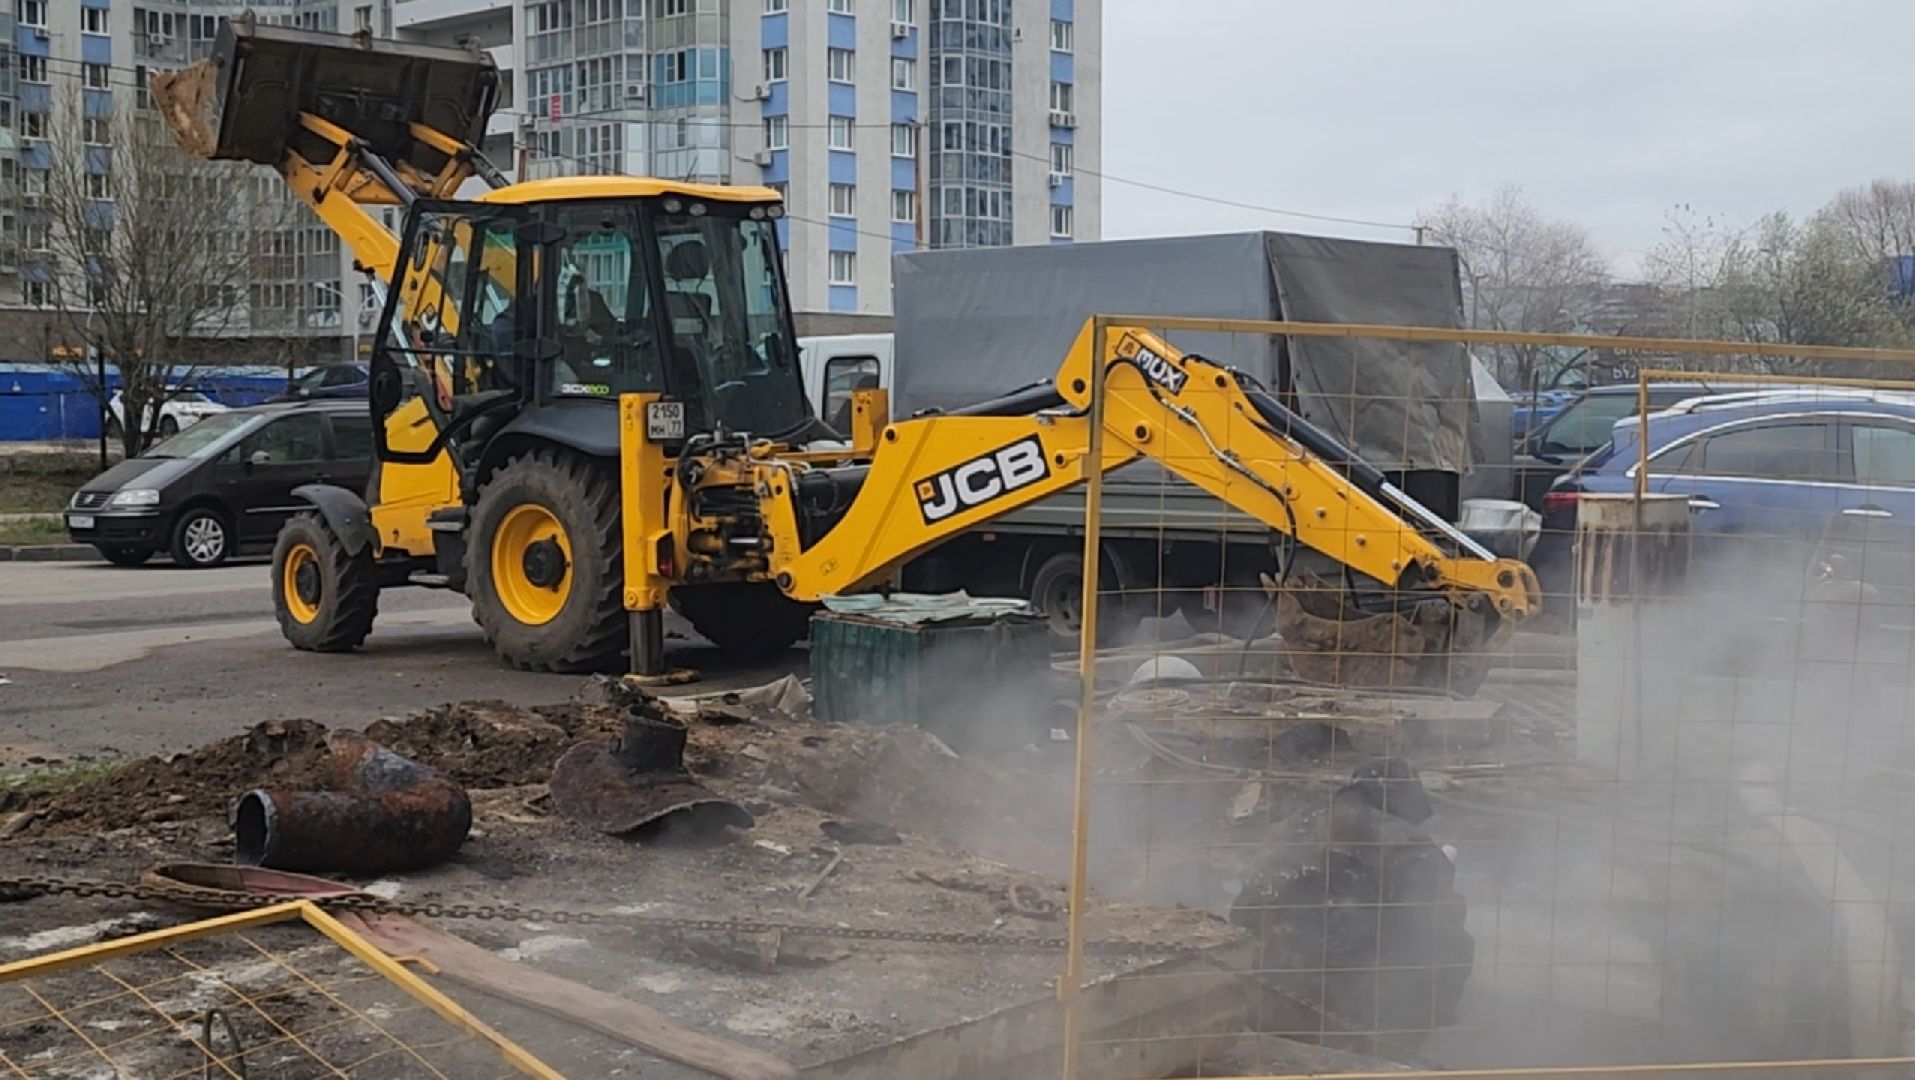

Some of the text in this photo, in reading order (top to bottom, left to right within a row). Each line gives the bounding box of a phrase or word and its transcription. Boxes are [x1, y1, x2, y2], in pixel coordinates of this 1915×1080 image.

[652, 404, 680, 419] 2150
[671, 420, 682, 433] 77
[923, 440, 1046, 520] JCB
